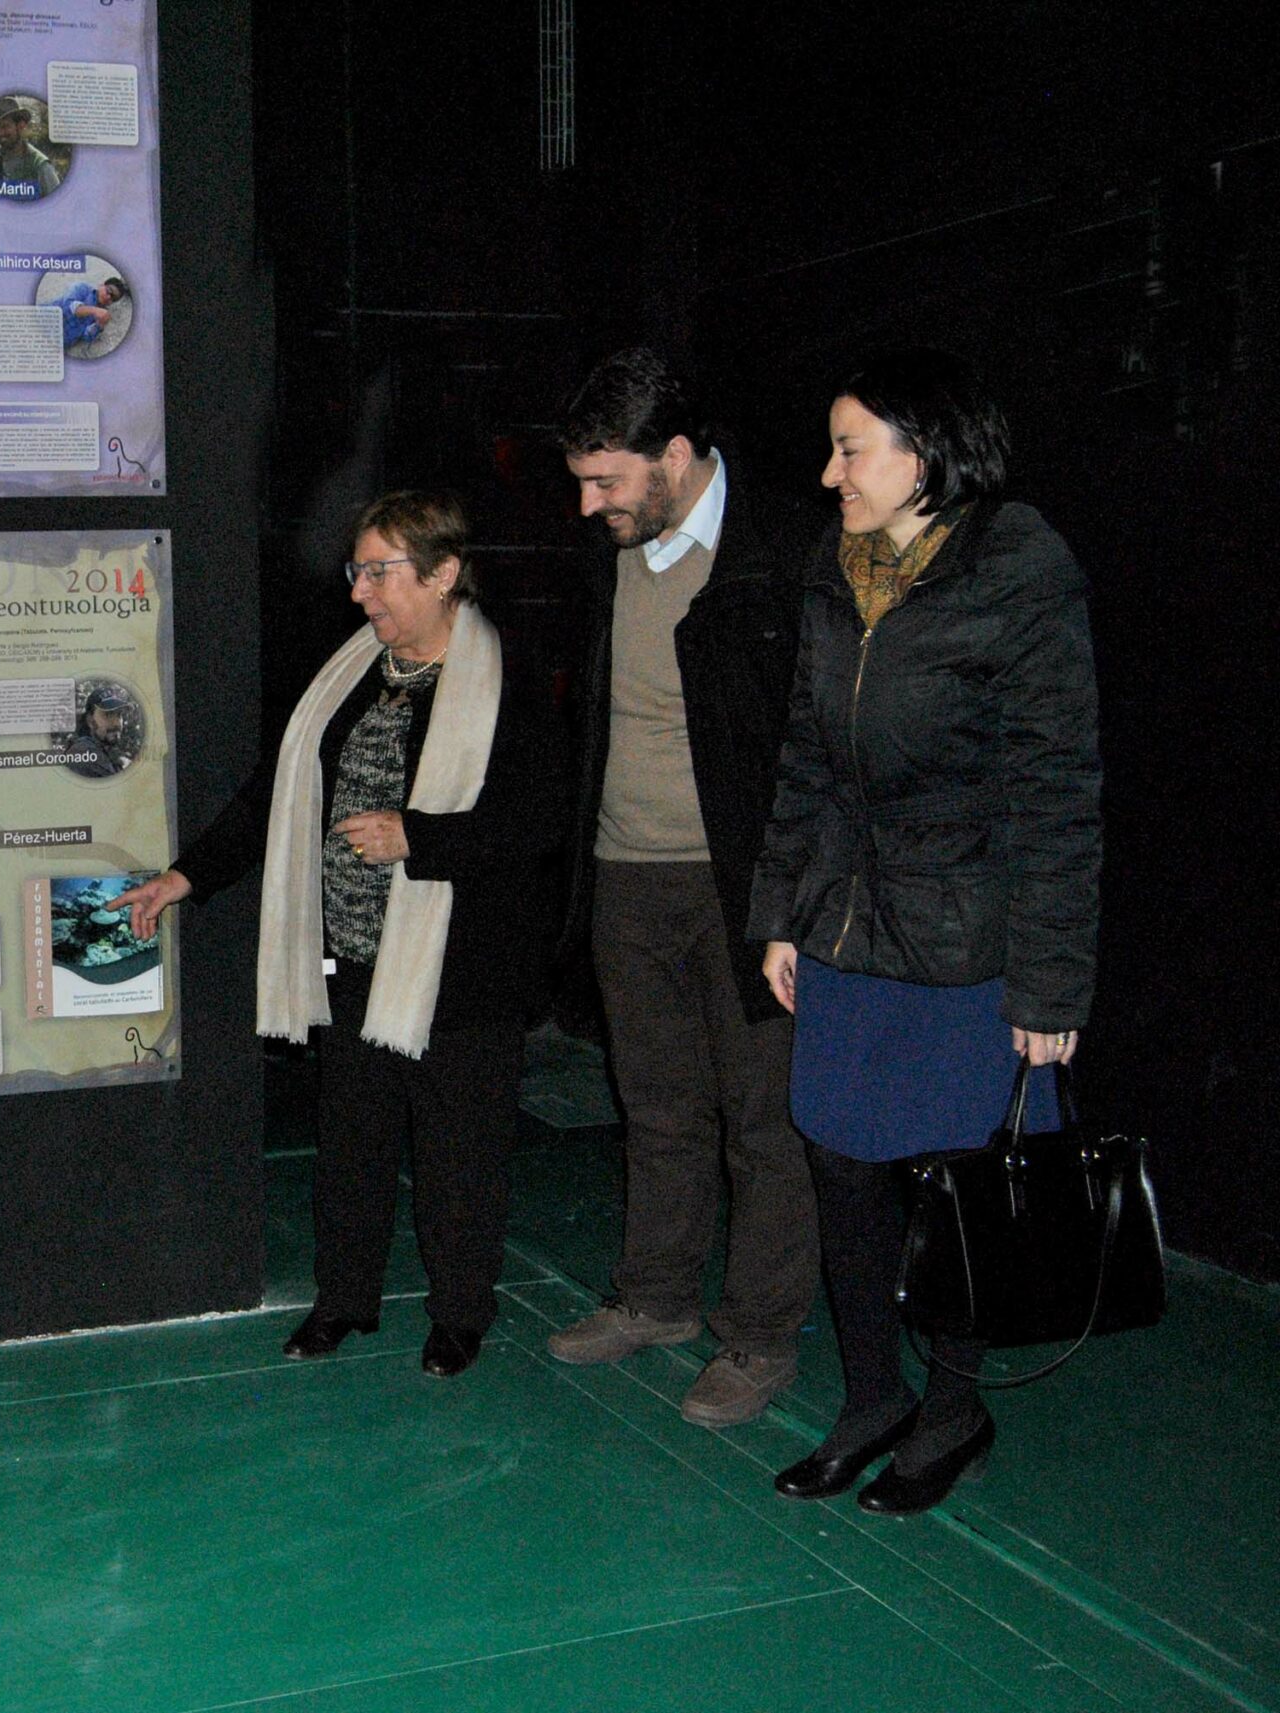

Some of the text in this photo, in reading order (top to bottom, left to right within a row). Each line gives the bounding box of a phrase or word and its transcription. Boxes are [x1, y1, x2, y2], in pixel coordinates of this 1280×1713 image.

[33, 256, 82, 270] Katsura
[66, 567, 145, 599] 2014
[36, 750, 98, 765] Coronado
[3, 829, 87, 845] Pérez-Huerta
